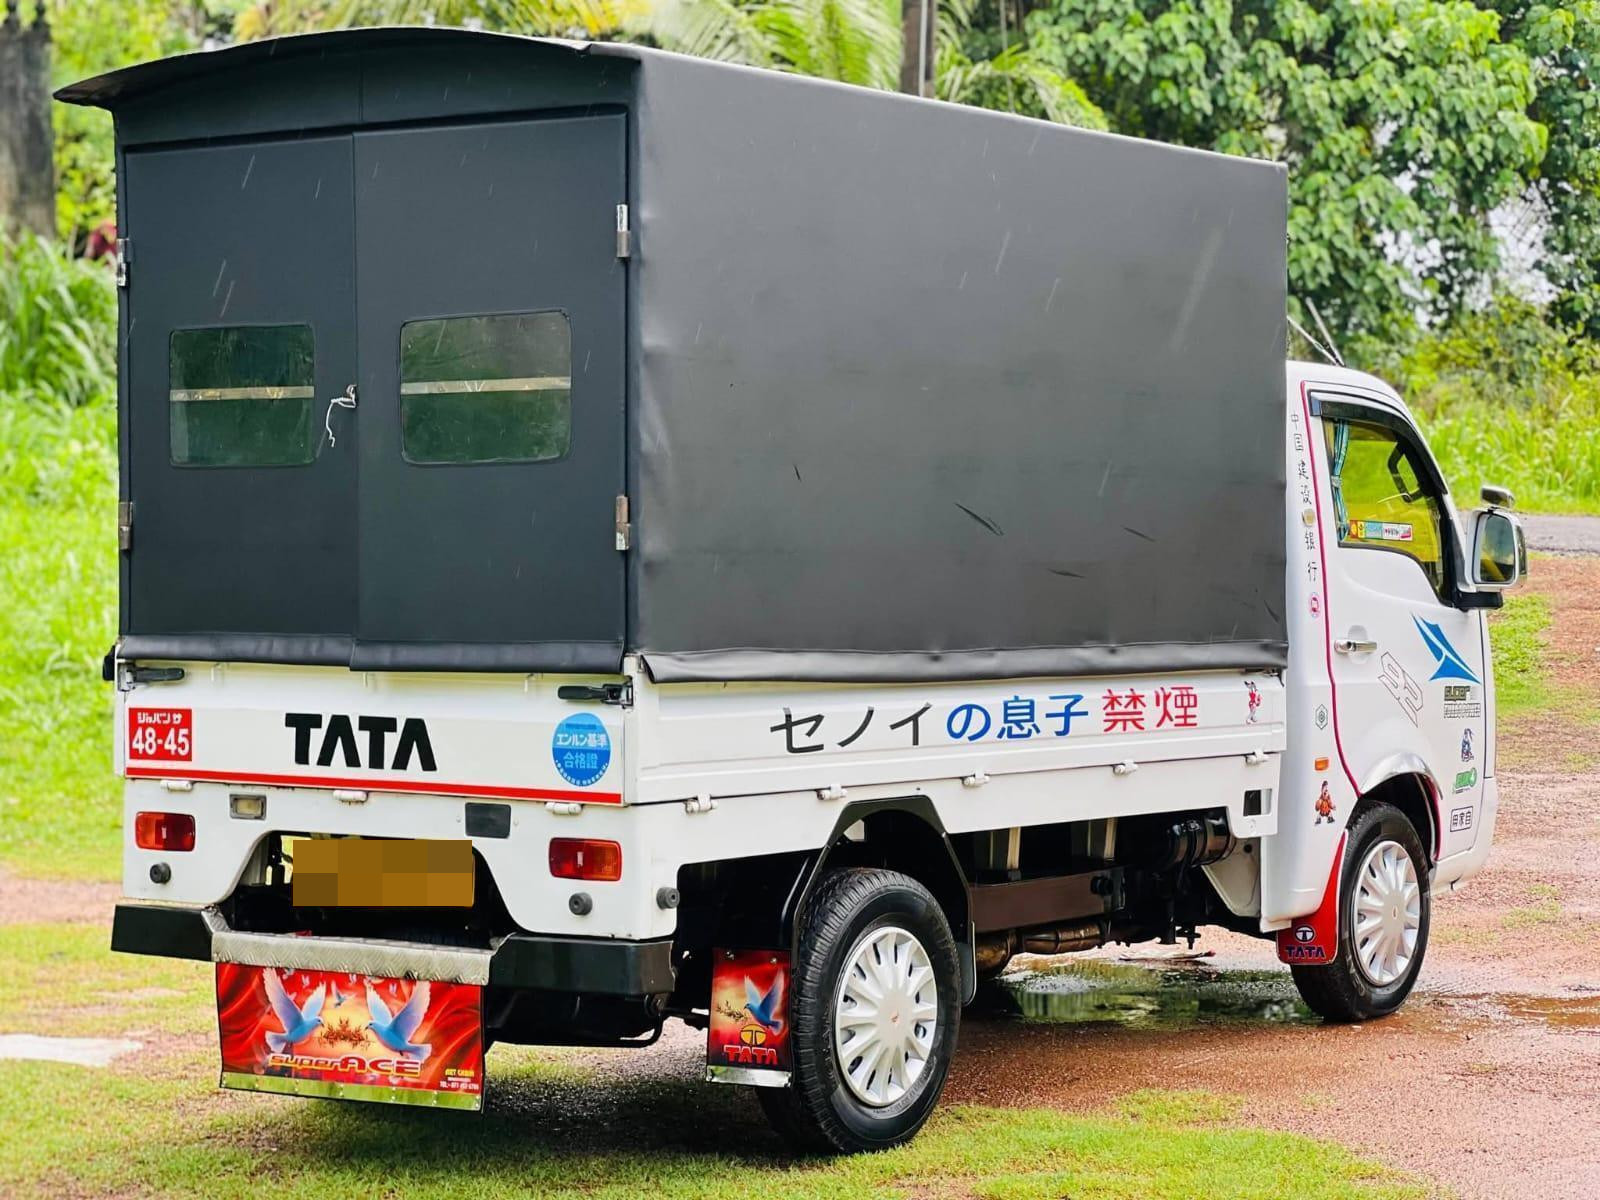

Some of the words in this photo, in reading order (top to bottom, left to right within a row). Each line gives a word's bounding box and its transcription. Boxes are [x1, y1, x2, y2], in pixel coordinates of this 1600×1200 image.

[132, 726, 190, 757] 48-45
[285, 712, 438, 772] TATA
[1284, 944, 1326, 960] TATA
[723, 1045, 779, 1066] TATA
